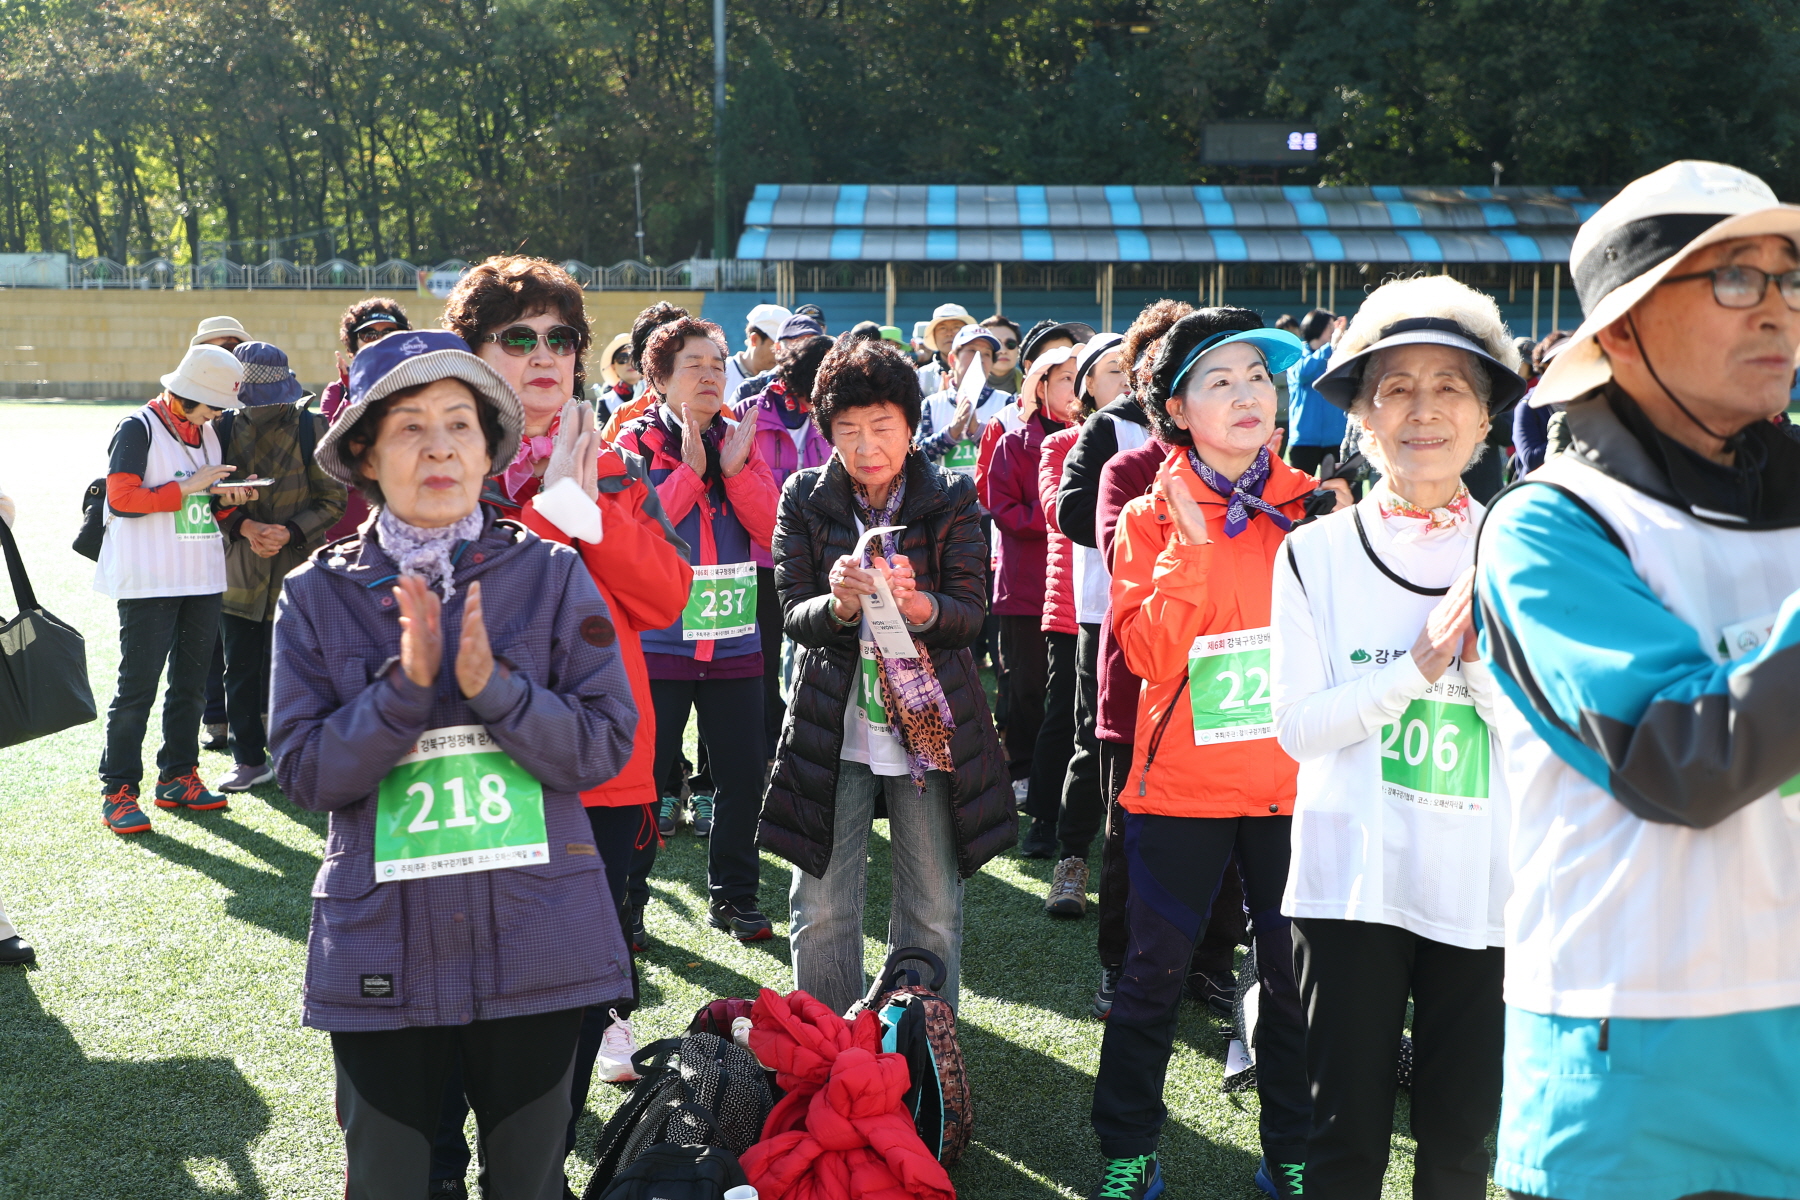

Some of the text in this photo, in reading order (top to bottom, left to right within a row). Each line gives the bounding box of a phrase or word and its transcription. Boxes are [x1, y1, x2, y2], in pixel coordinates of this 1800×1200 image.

[700, 588, 746, 617] 237
[1207, 639, 1225, 650] 제6회
[1215, 667, 1271, 710] 22
[1447, 684, 1473, 699] 걷기대
[421, 734, 475, 752] 강북구청장배
[1381, 718, 1460, 772] 206
[406, 773, 512, 833] 218
